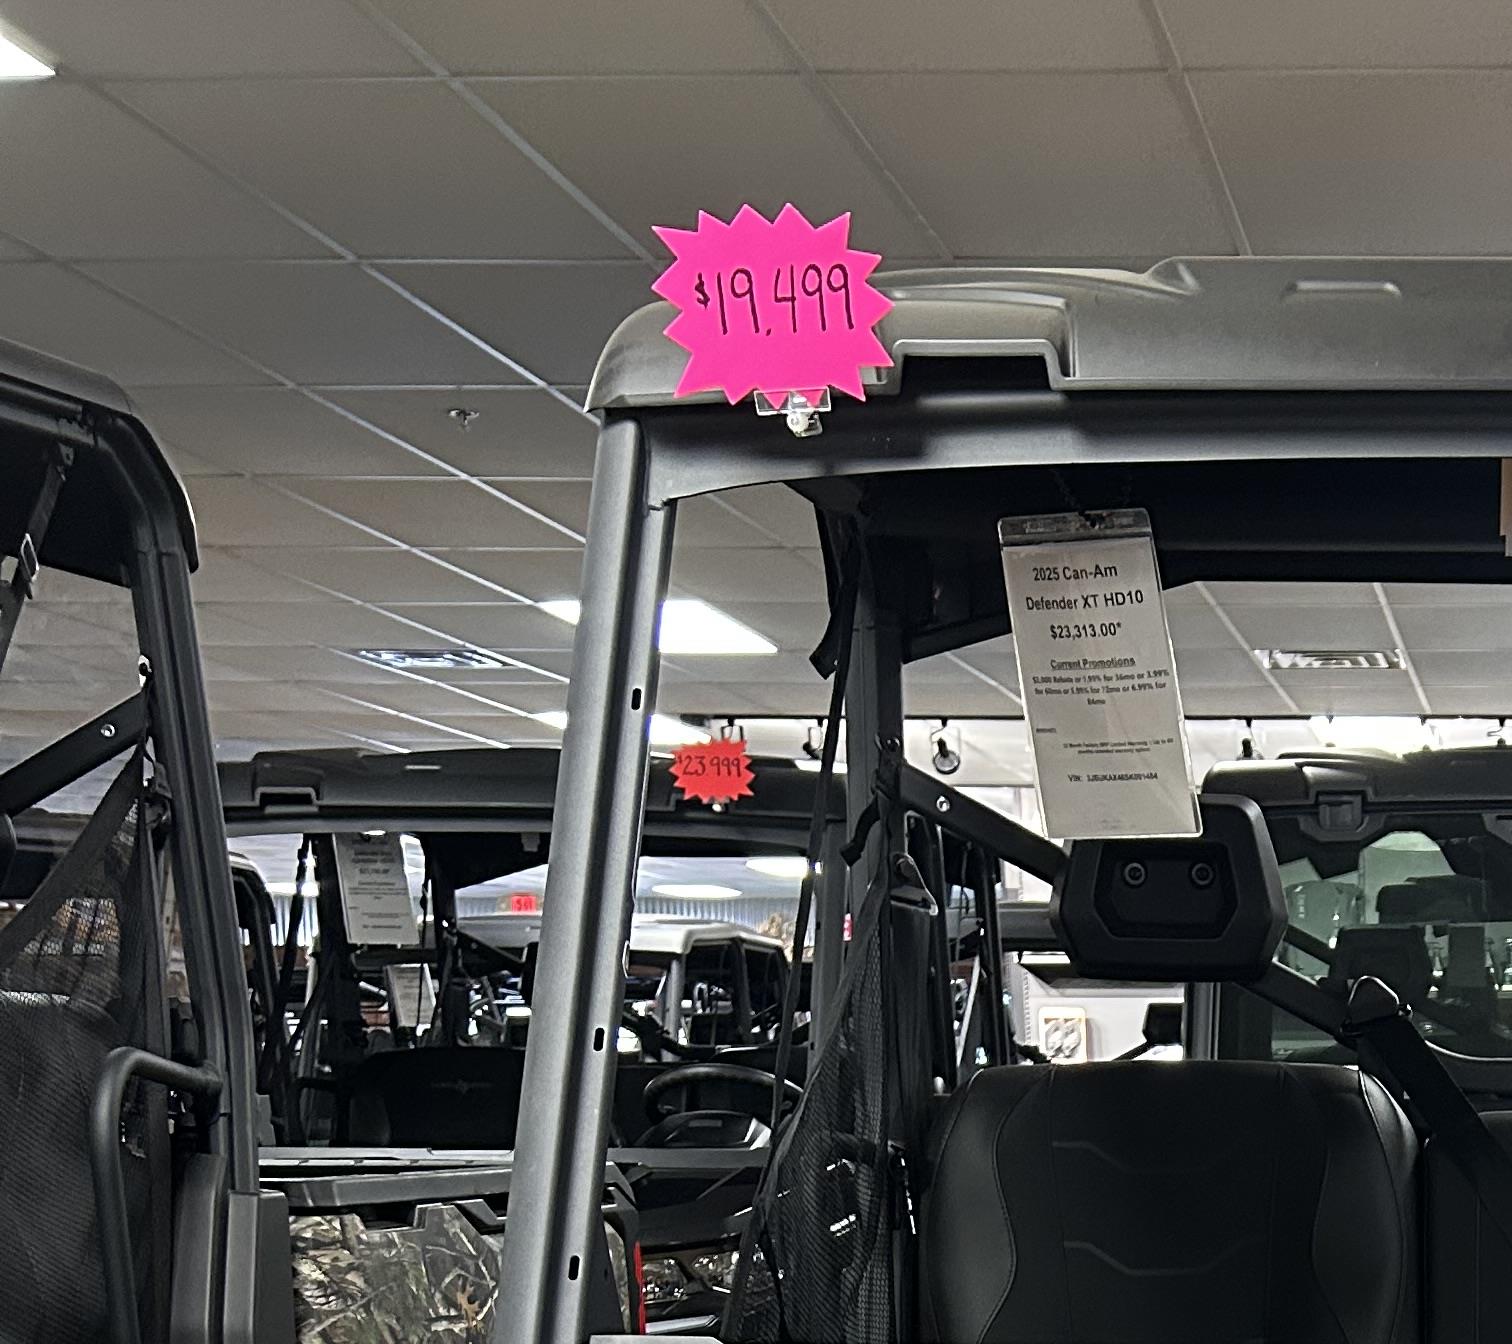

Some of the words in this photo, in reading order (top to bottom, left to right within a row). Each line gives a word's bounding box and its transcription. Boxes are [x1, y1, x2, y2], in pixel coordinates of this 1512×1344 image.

[1032, 567, 1060, 581] 2025
[1062, 564, 1118, 580] Can-Am
[1026, 596, 1078, 610] Defender
[1081, 594, 1099, 609] XT
[1104, 589, 1144, 607] HD10
[1050, 659, 1080, 671] Current
[1082, 657, 1136, 669] Promotions
